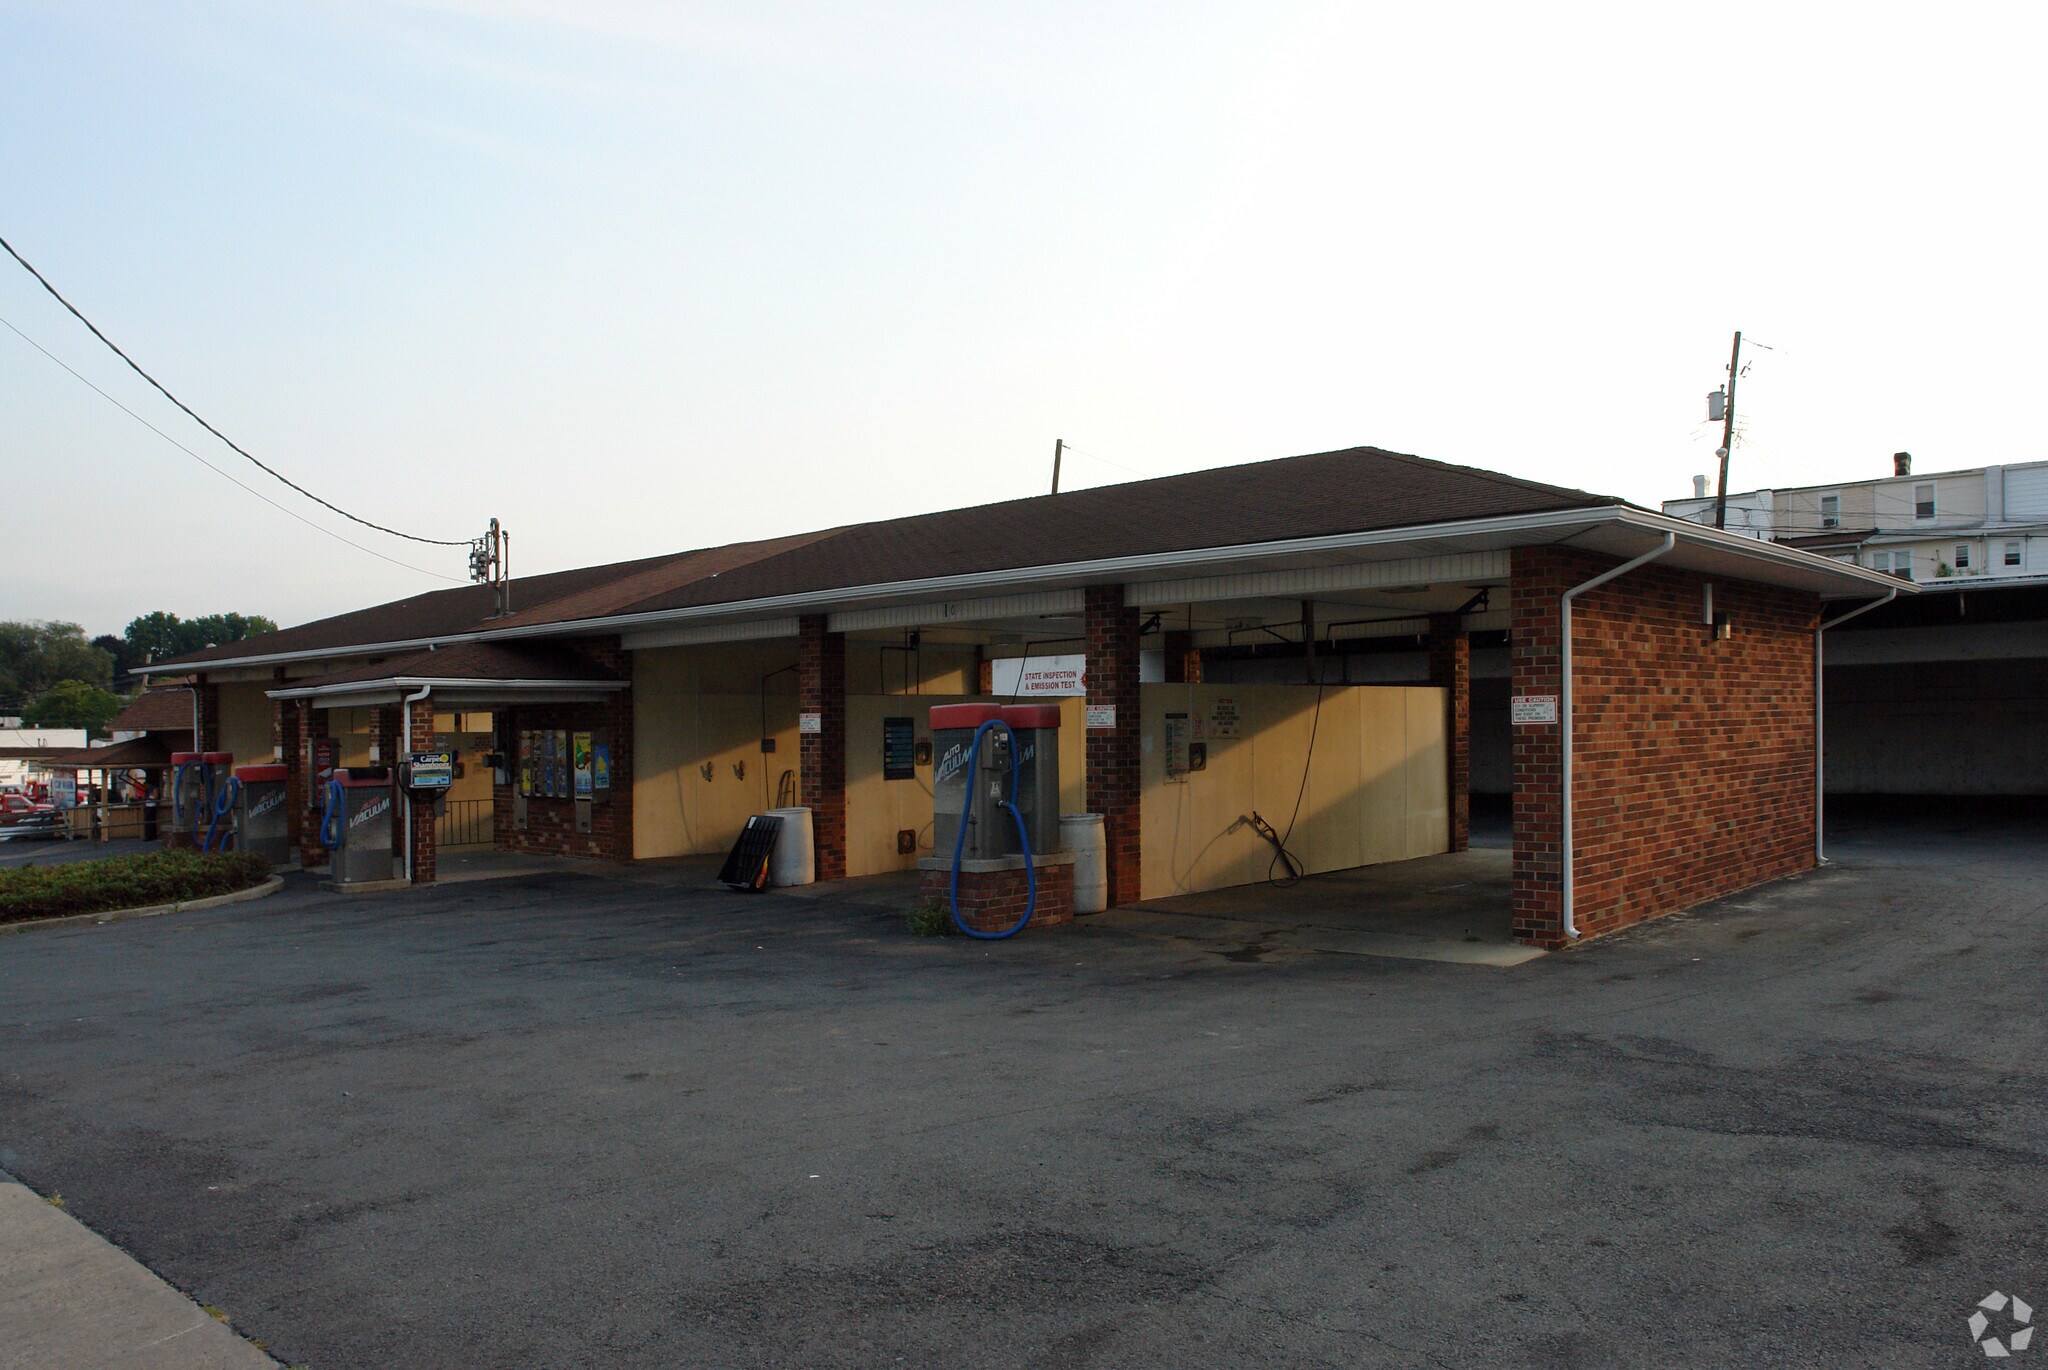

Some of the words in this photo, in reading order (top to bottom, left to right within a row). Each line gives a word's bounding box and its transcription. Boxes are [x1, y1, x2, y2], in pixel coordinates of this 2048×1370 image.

[1025, 672, 1041, 680] STATE
[1043, 670, 1077, 680] INSPECTION
[1025, 682, 1029, 690] &
[1031, 681, 1059, 690] EMISSION
[944, 744, 960, 760] AUTO
[935, 745, 973, 784] VACUUM
[248, 791, 286, 818] VACUUM
[349, 797, 390, 828] VACUUM
